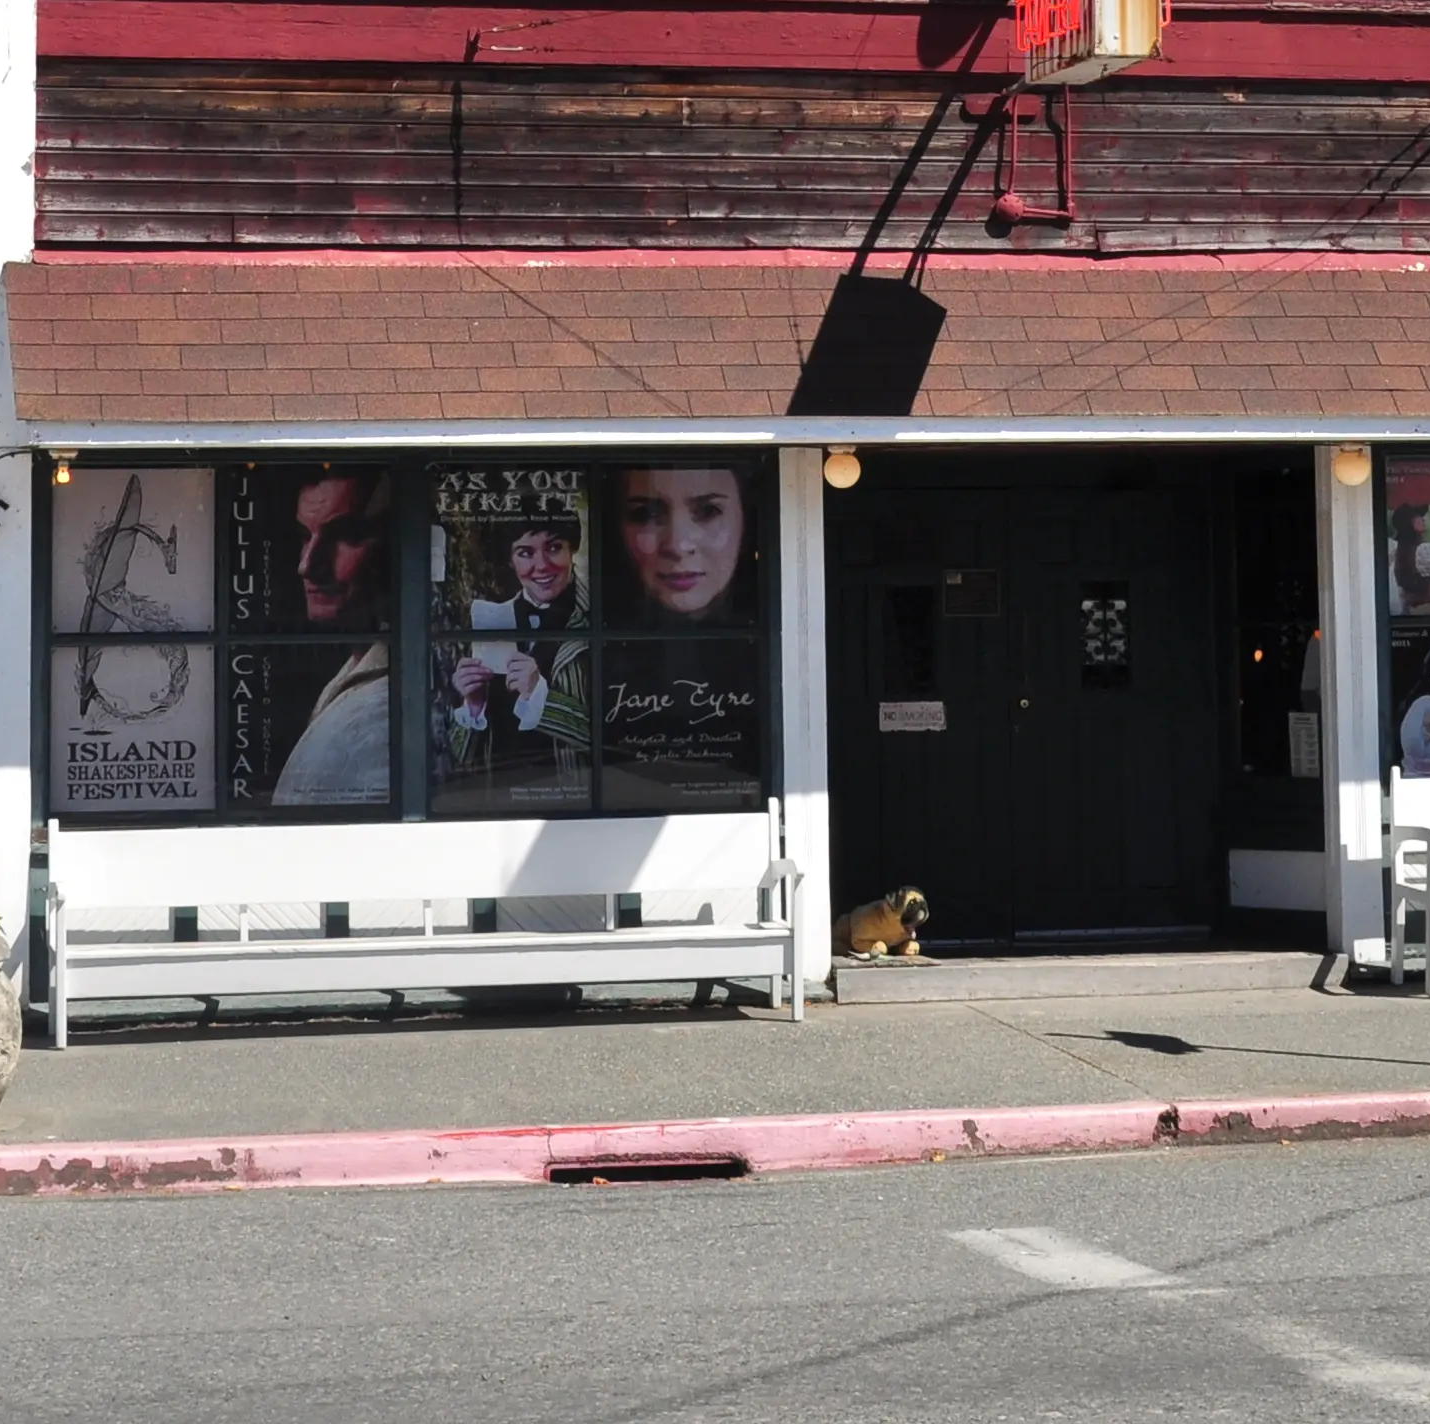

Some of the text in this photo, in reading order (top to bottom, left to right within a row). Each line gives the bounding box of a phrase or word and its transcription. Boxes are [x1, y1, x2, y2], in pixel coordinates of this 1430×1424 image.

[436, 469, 586, 492] AS YOU
[435, 491, 583, 514] LIKE IT
[232, 477, 255, 620] JULIUS
[605, 678, 756, 725] Jane Eyre
[231, 653, 254, 799] CAESAR
[883, 711, 898, 722] NO
[67, 739, 198, 763] ISLAND
[672, 733, 693, 746] and
[67, 762, 196, 782] SHAKESPEARE
[66, 781, 198, 801] FESTIVAL
